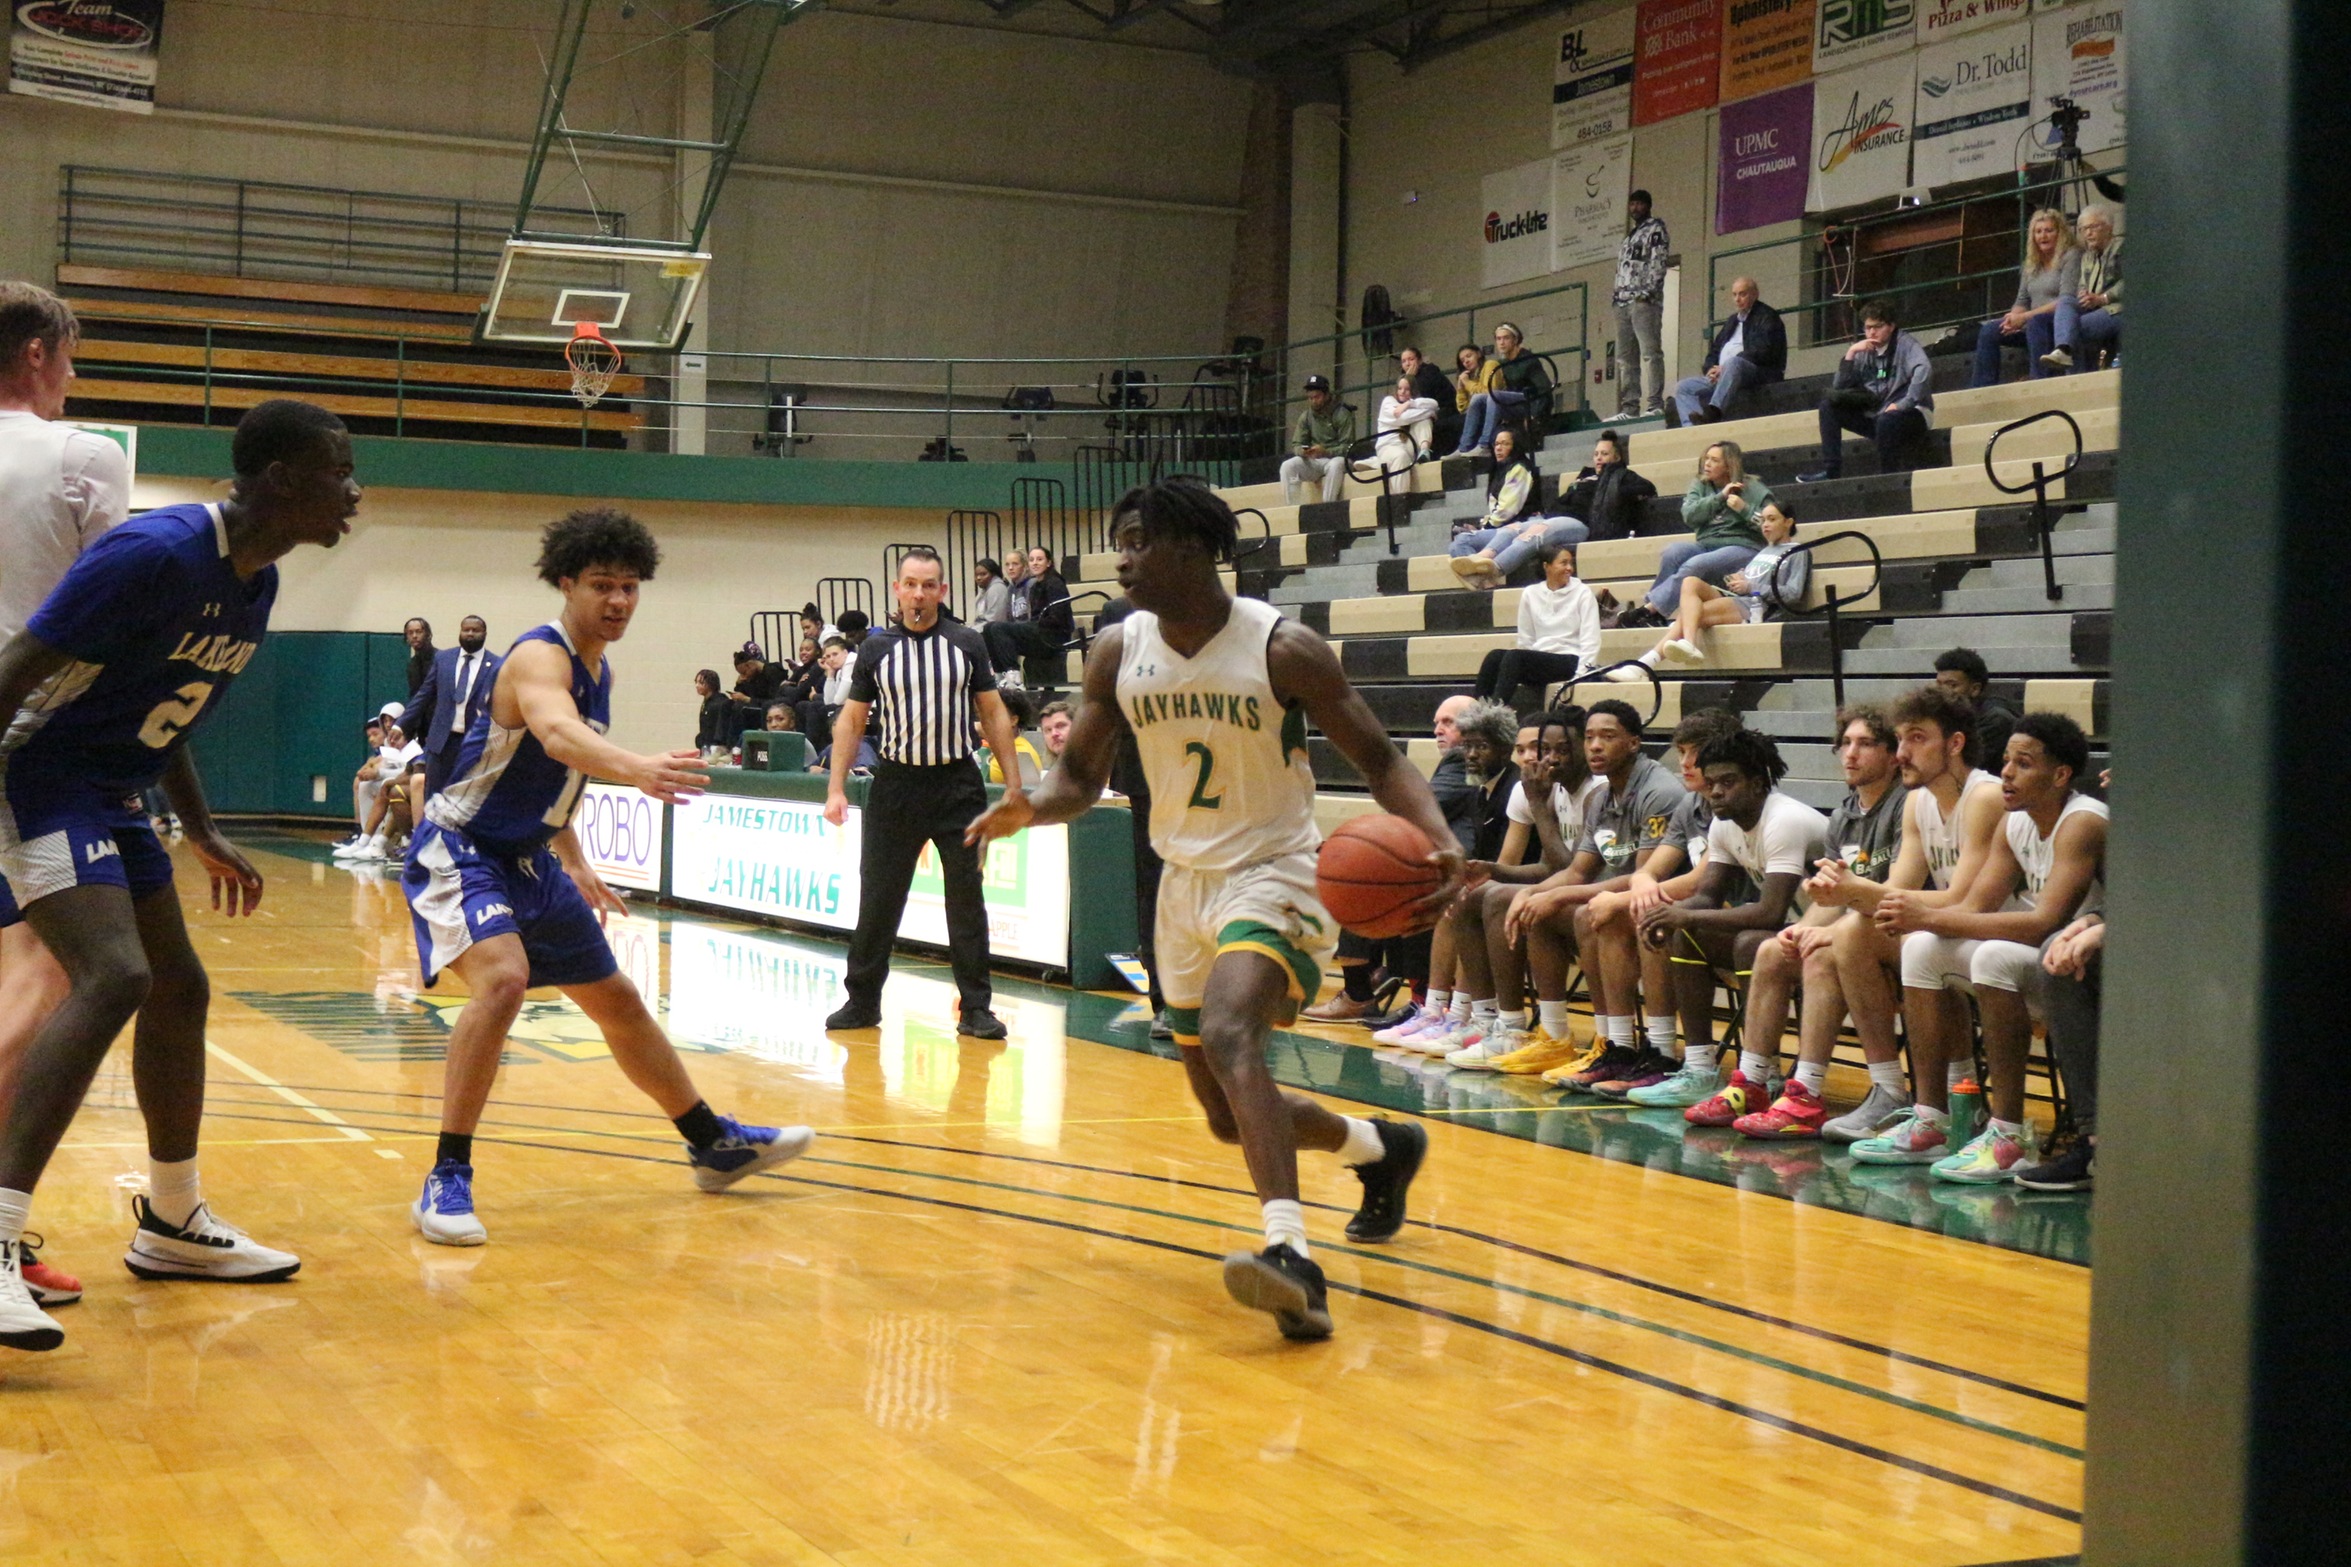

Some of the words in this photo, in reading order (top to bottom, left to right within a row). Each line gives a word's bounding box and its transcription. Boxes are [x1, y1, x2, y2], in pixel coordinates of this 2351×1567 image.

[66, 0, 113, 15] Team
[1643, 0, 1715, 33] Community
[1928, 9, 1963, 29] Pizza
[1966, 2, 1979, 18] &
[1666, 21, 1698, 51] Bank
[1956, 61, 1981, 86] Dr.
[1983, 44, 2027, 79] Todd
[1577, 120, 1613, 140] 484-0158
[1735, 128, 1779, 156] UPMC
[1818, 90, 1894, 172] Ames
[1854, 128, 1905, 154] INSURANCE
[1736, 155, 1797, 180] CHAUTAUQUA
[137, 680, 214, 749] 2
[1132, 692, 1260, 731] JAYHAWKS
[1183, 738, 1226, 812] 2
[1648, 817, 1666, 839] 32
[708, 856, 842, 915] JAYHAWKS
